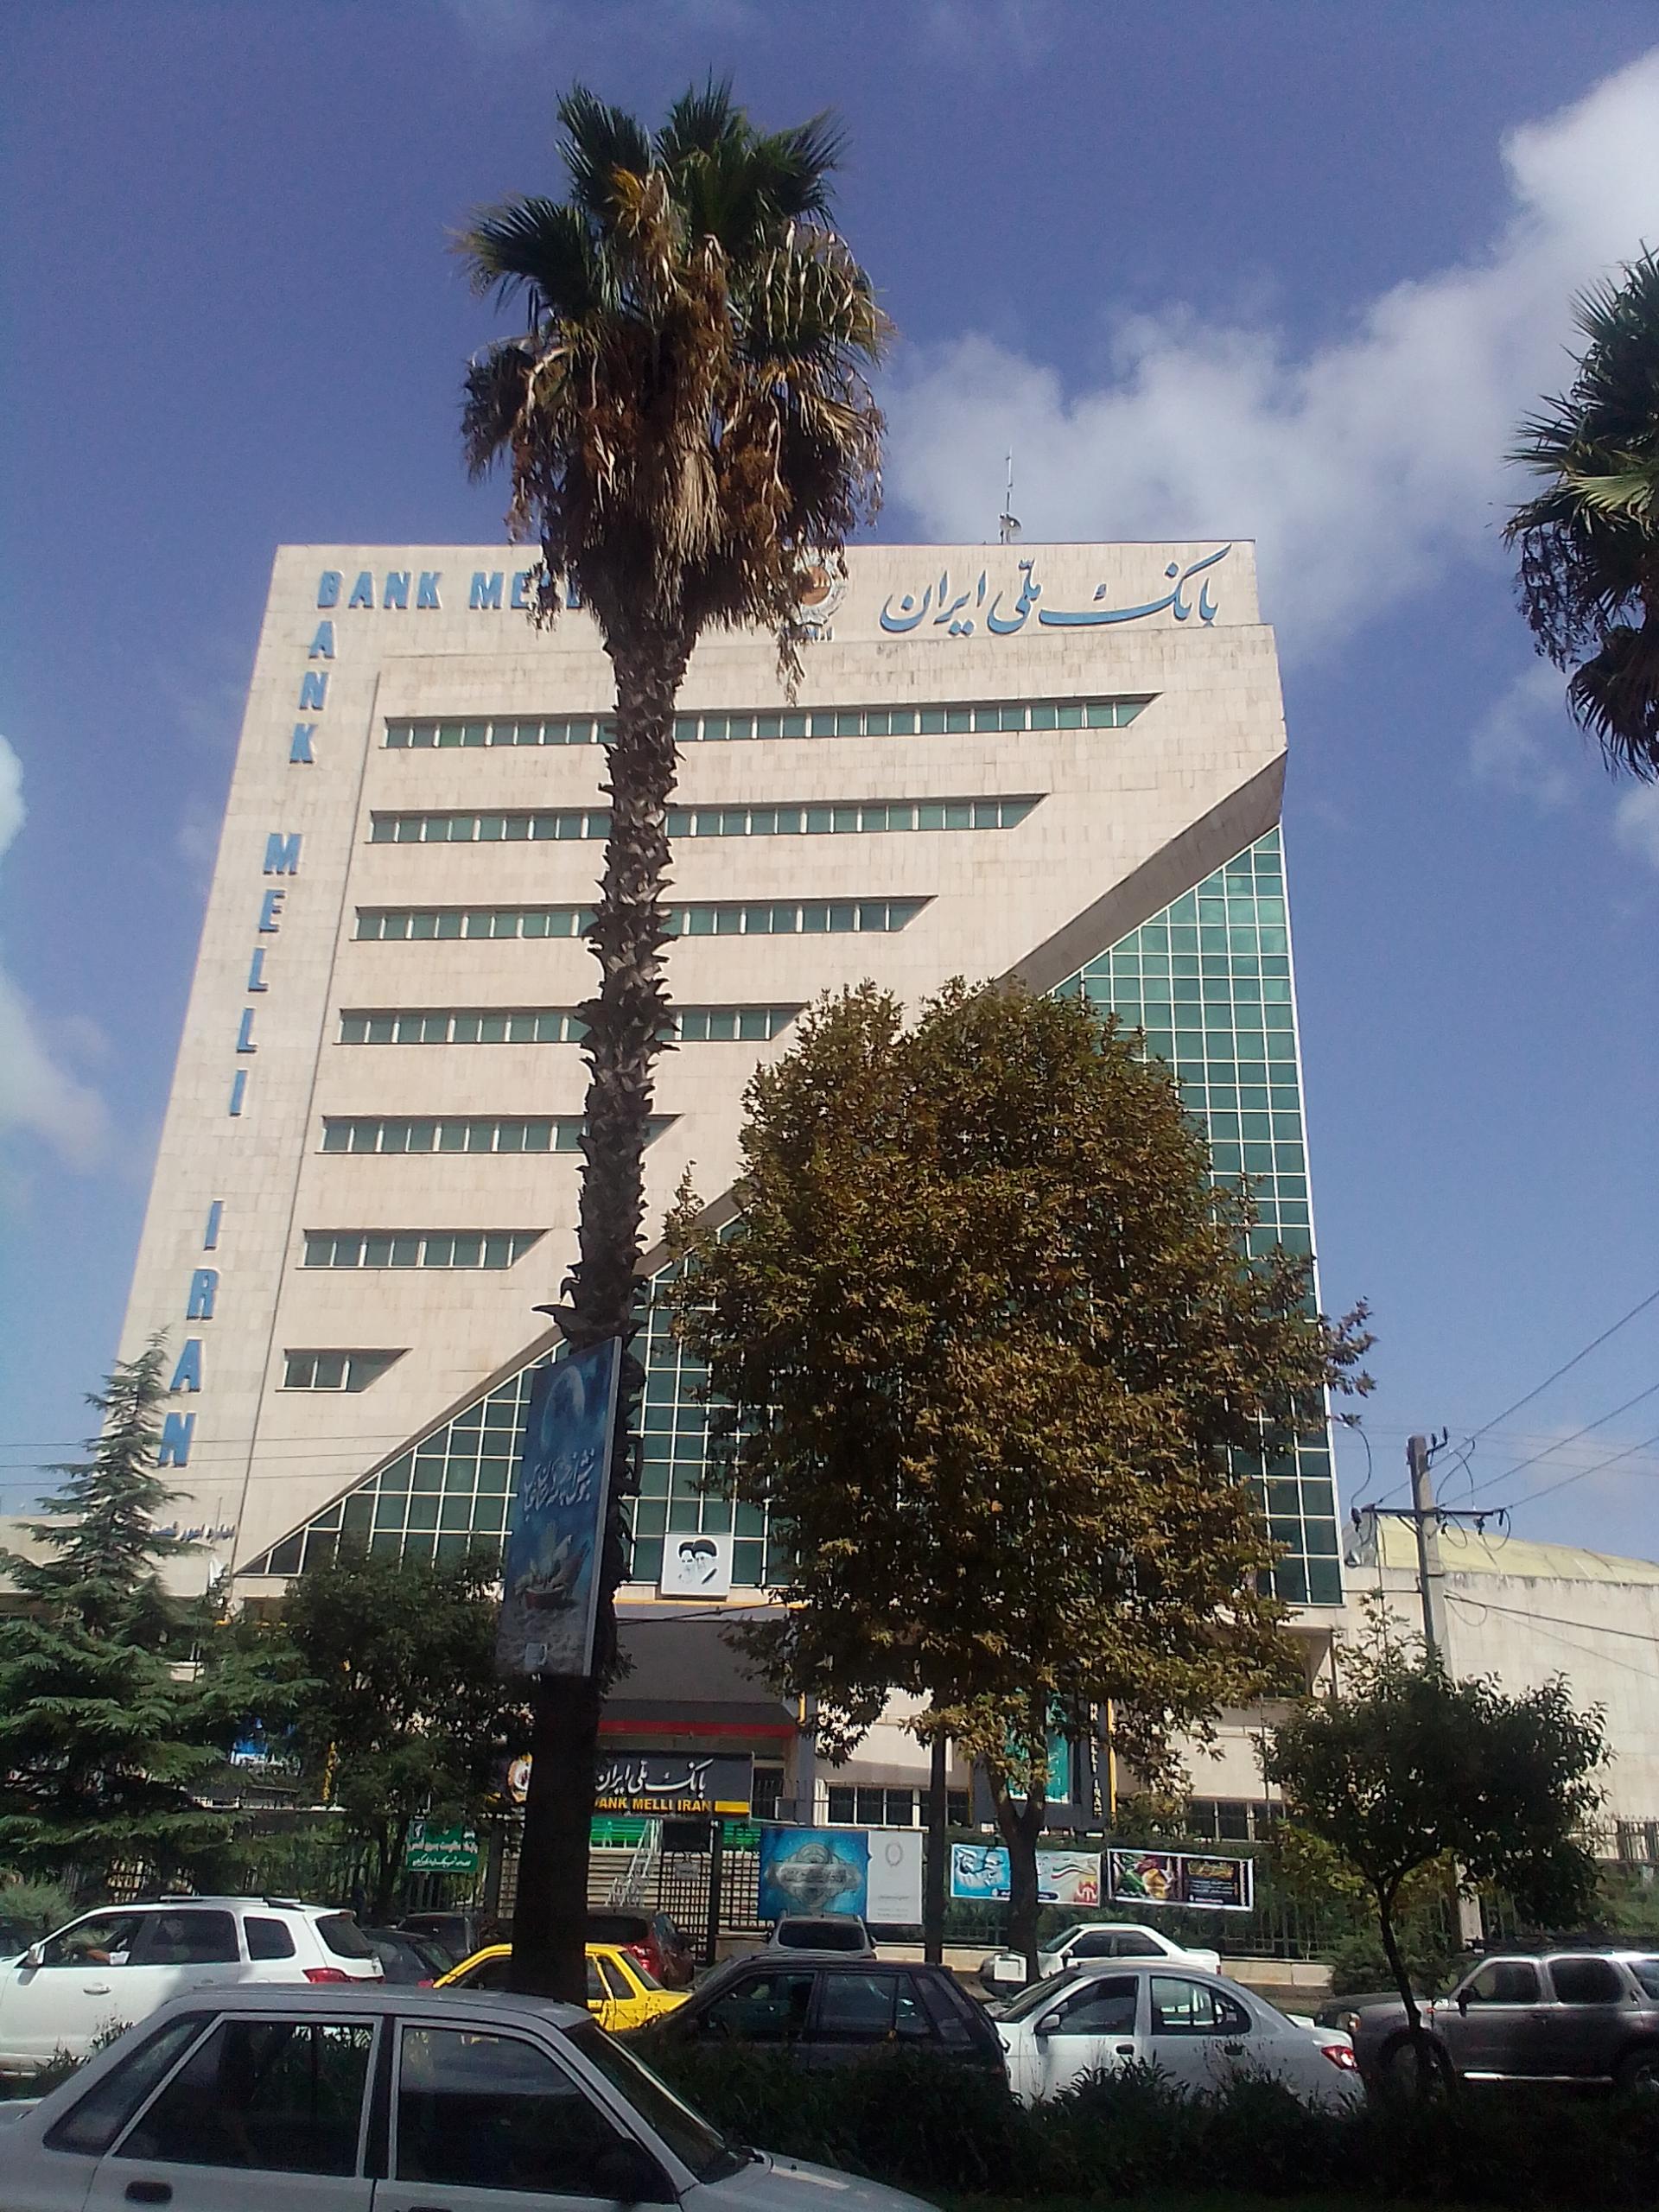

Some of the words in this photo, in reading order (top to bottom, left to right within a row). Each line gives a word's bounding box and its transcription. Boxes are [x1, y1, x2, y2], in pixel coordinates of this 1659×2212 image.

[317, 570, 442, 609] BANK
[880, 569, 986, 636] ایران
[1039, 543, 1231, 626] بانک
[229, 832, 302, 1115] MELLI
[157, 1200, 223, 1467] IRAN
[594, 1797, 627, 1809] ANK
[632, 1799, 673, 1811] MELLI
[677, 1800, 711, 1812] IRAN
[595, 1764, 631, 1795] ایران
[645, 1758, 715, 1799] بانک
